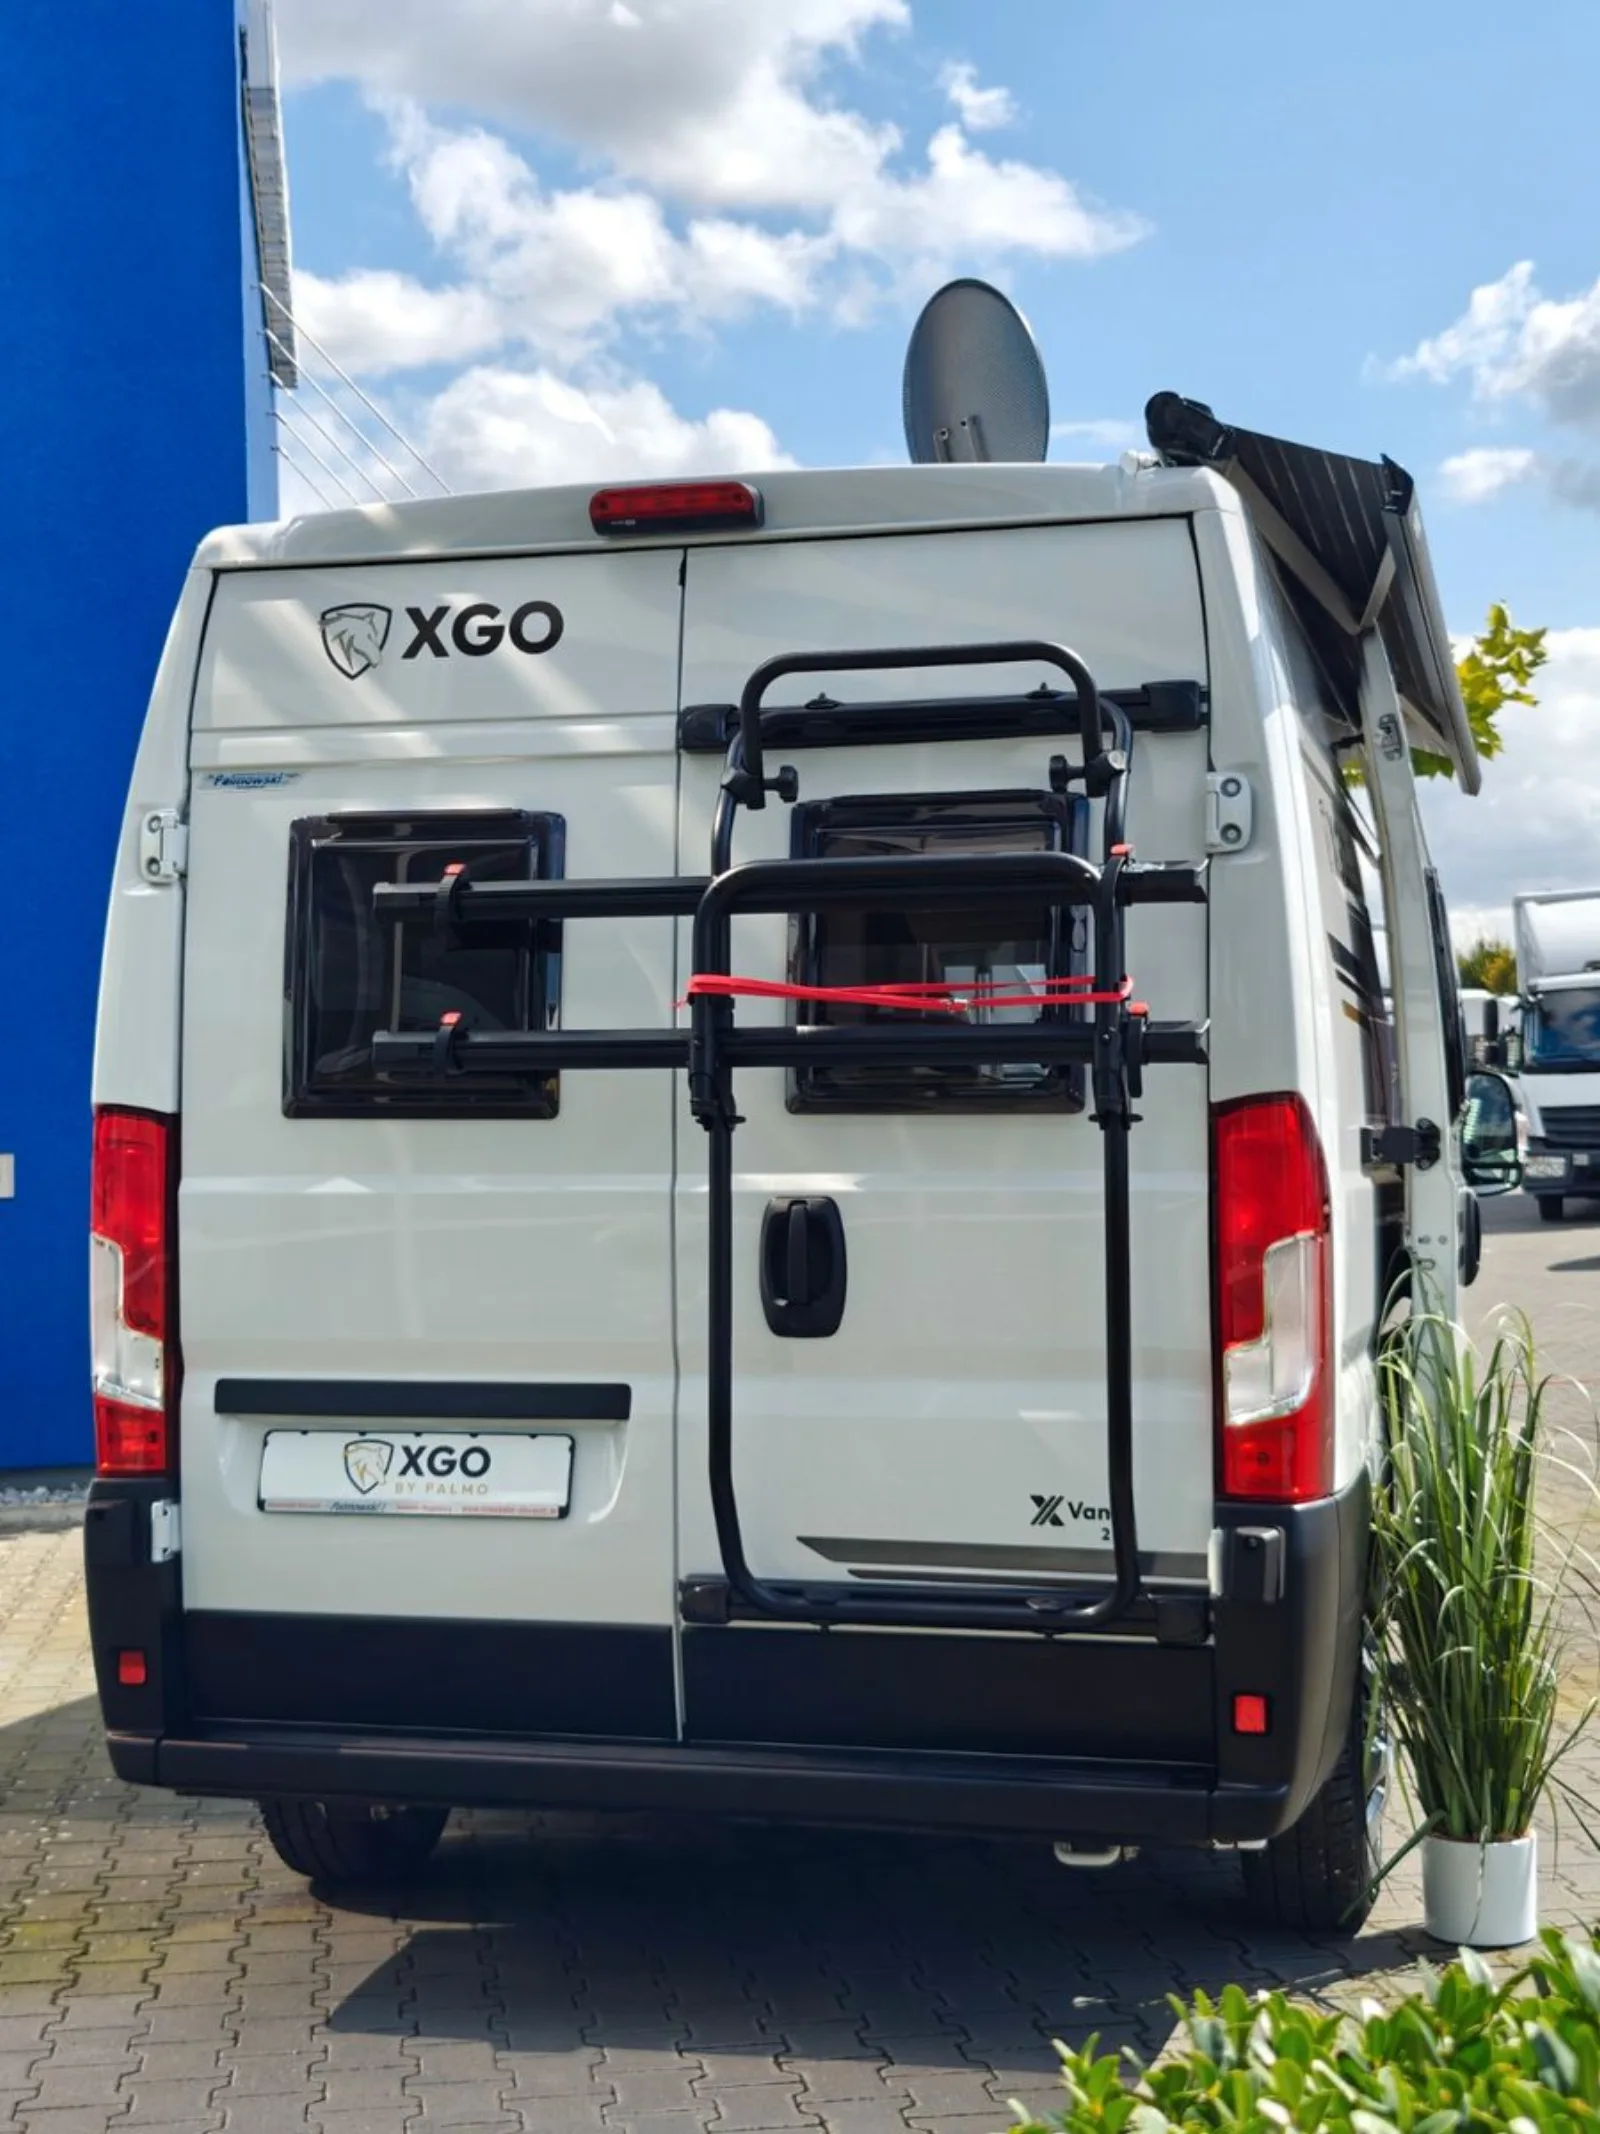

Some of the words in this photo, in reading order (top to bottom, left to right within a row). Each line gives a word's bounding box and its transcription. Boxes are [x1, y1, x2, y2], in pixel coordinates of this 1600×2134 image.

[402, 600, 564, 659] XGO
[399, 1445, 491, 1478] XGO
[395, 1482, 416, 1494] BY
[426, 1482, 489, 1495] PALMO
[1067, 1500, 1111, 1520] Van
